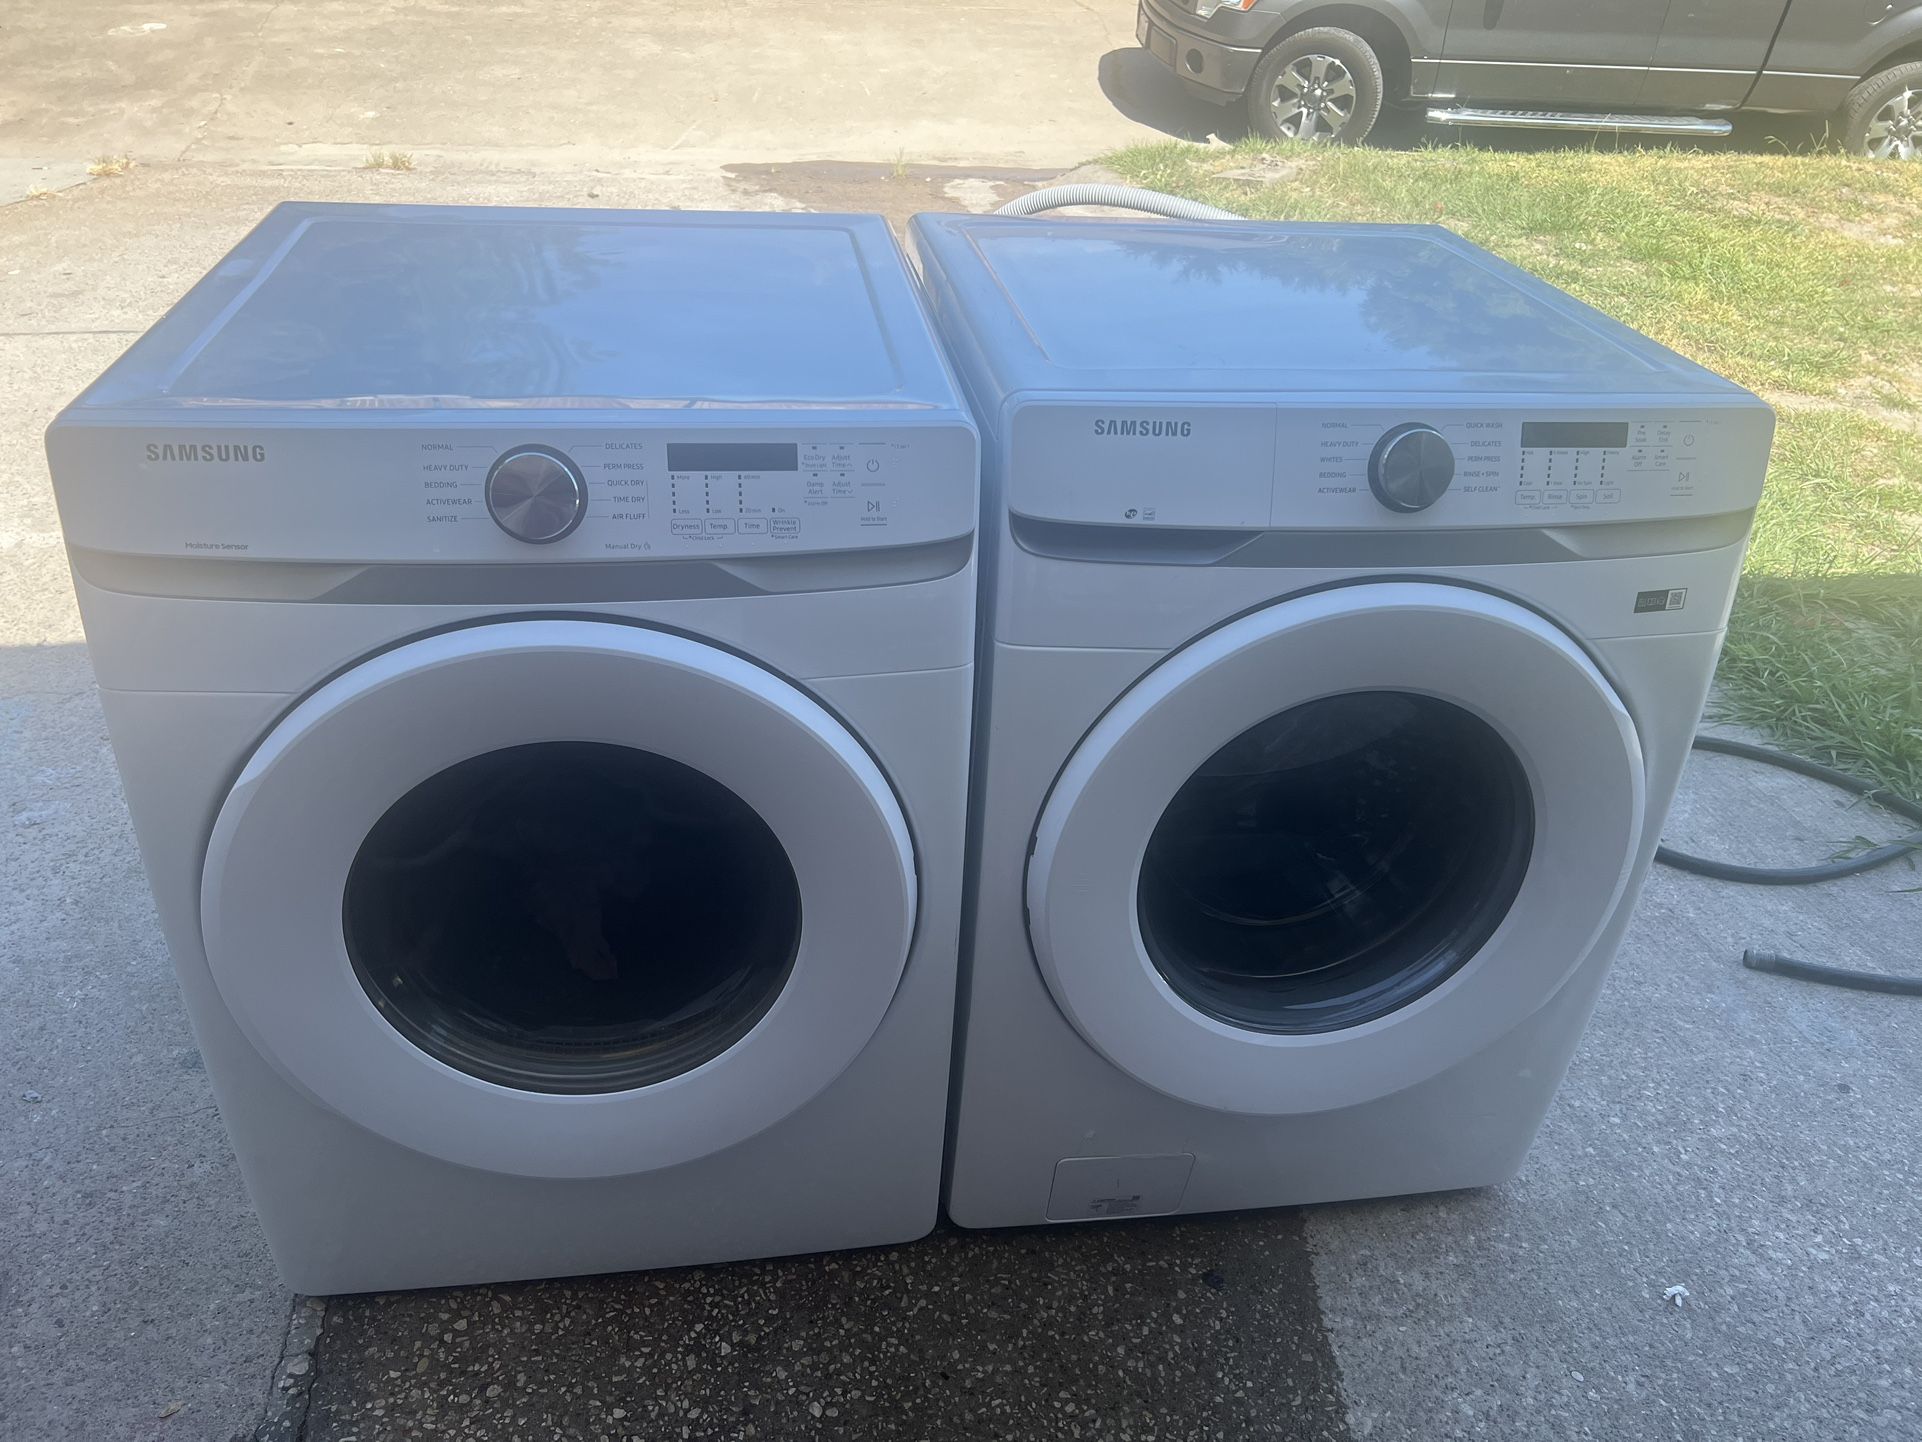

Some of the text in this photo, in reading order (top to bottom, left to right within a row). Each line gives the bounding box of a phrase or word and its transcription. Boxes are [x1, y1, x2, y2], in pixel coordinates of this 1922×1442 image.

[1094, 419, 1191, 437] SAMSUNG
[421, 443, 454, 451] NORMAL
[605, 442, 643, 450] DELICATES
[146, 443, 265, 462] SAMSUNG
[423, 464, 448, 472] HEAVY
[1319, 471, 1347, 479] BEDDING
[424, 481, 458, 489] BEDDING
[607, 480, 629, 488] QUICK
[426, 498, 473, 506] ACTIVEWEAR
[427, 515, 458, 523] SANITIZE
[672, 522, 700, 531] Dryness
[744, 521, 761, 530] Time
[772, 525, 797, 533] Prevent
[184, 541, 249, 551] Moisture Sensor
[605, 542, 643, 551] Manual Dry
